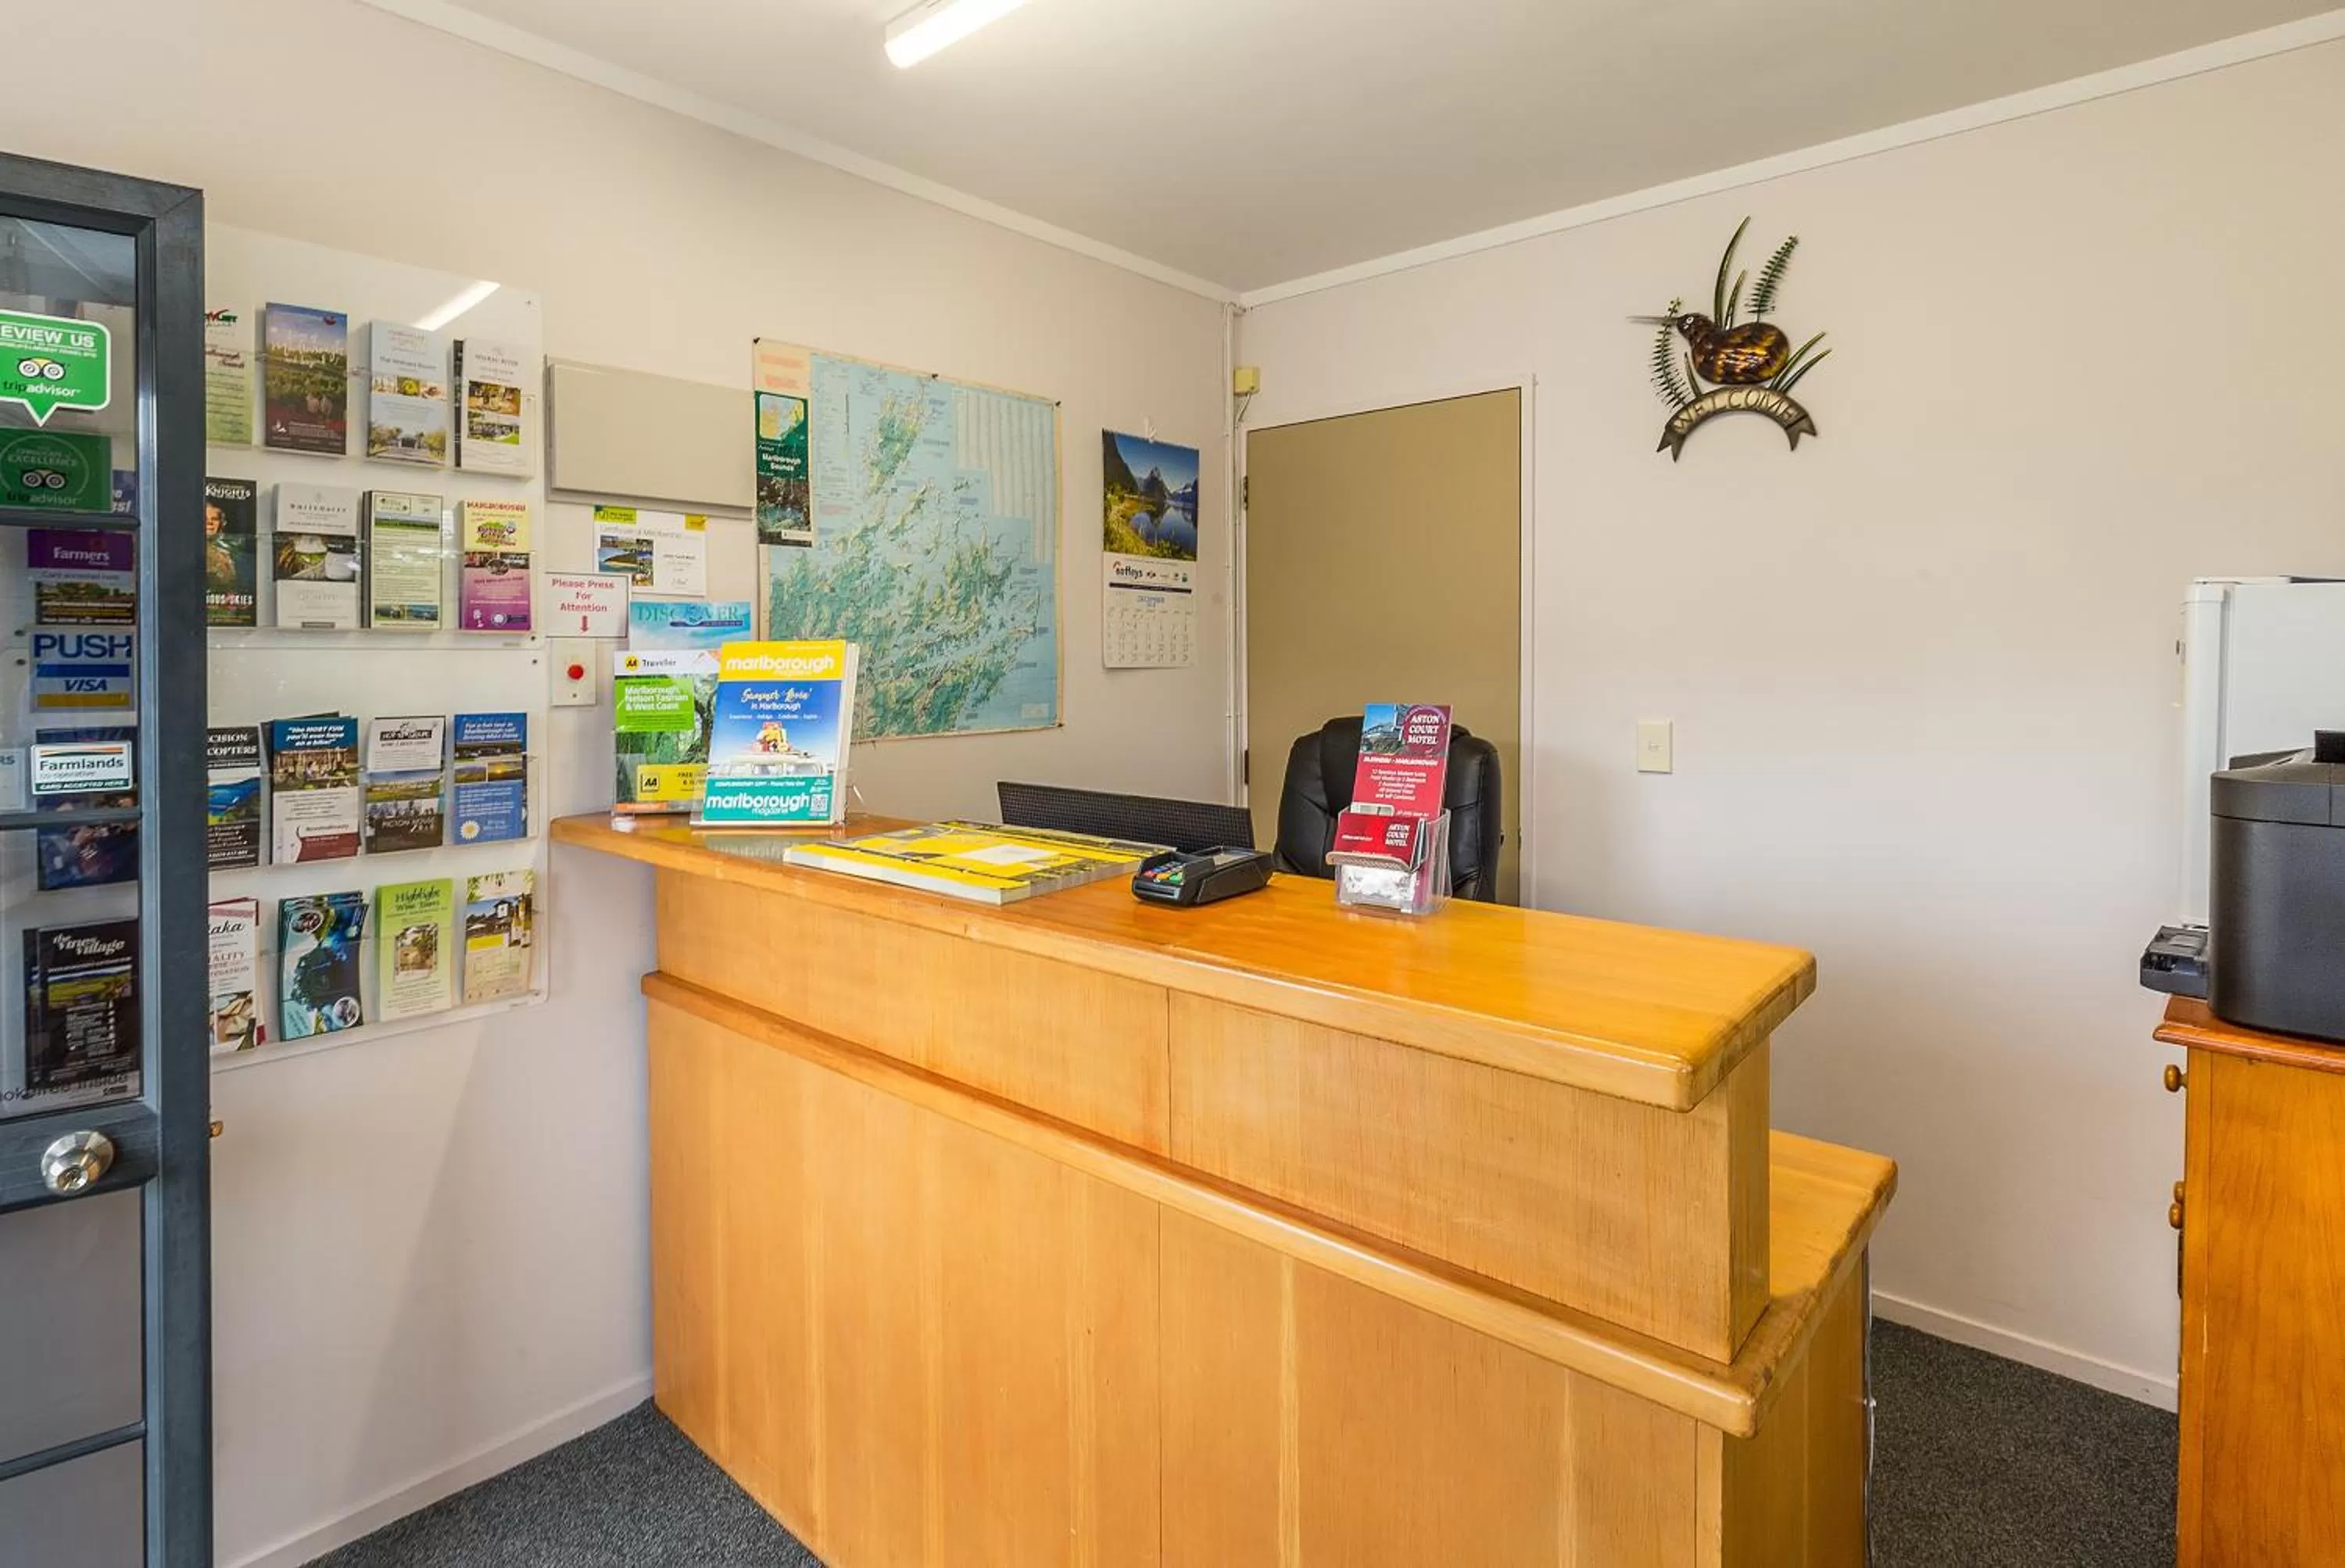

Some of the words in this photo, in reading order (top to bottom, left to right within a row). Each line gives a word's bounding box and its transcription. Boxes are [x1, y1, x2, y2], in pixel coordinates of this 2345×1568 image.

[70, 333, 95, 348] US
[3, 381, 77, 397] tripadvisor
[1673, 389, 1795, 431] WELCOME
[6, 492, 77, 505] tripadvisor
[53, 546, 109, 562] Farmers
[552, 578, 585, 588] Please
[575, 591, 592, 600] For
[560, 603, 607, 613] Attention
[637, 606, 739, 623] DISCOVER
[34, 634, 132, 658] PUSH
[725, 654, 835, 674] marlborough
[64, 678, 108, 692] VISA
[758, 703, 801, 711] Marlborough
[1411, 714, 1439, 725] ASTON
[1409, 725, 1439, 735] COURT
[1407, 734, 1438, 745] MOTEL
[40, 755, 124, 771] Farmlands
[644, 777, 657, 787] AA
[706, 793, 810, 813] marlborough
[1386, 831, 1409, 839] COURT
